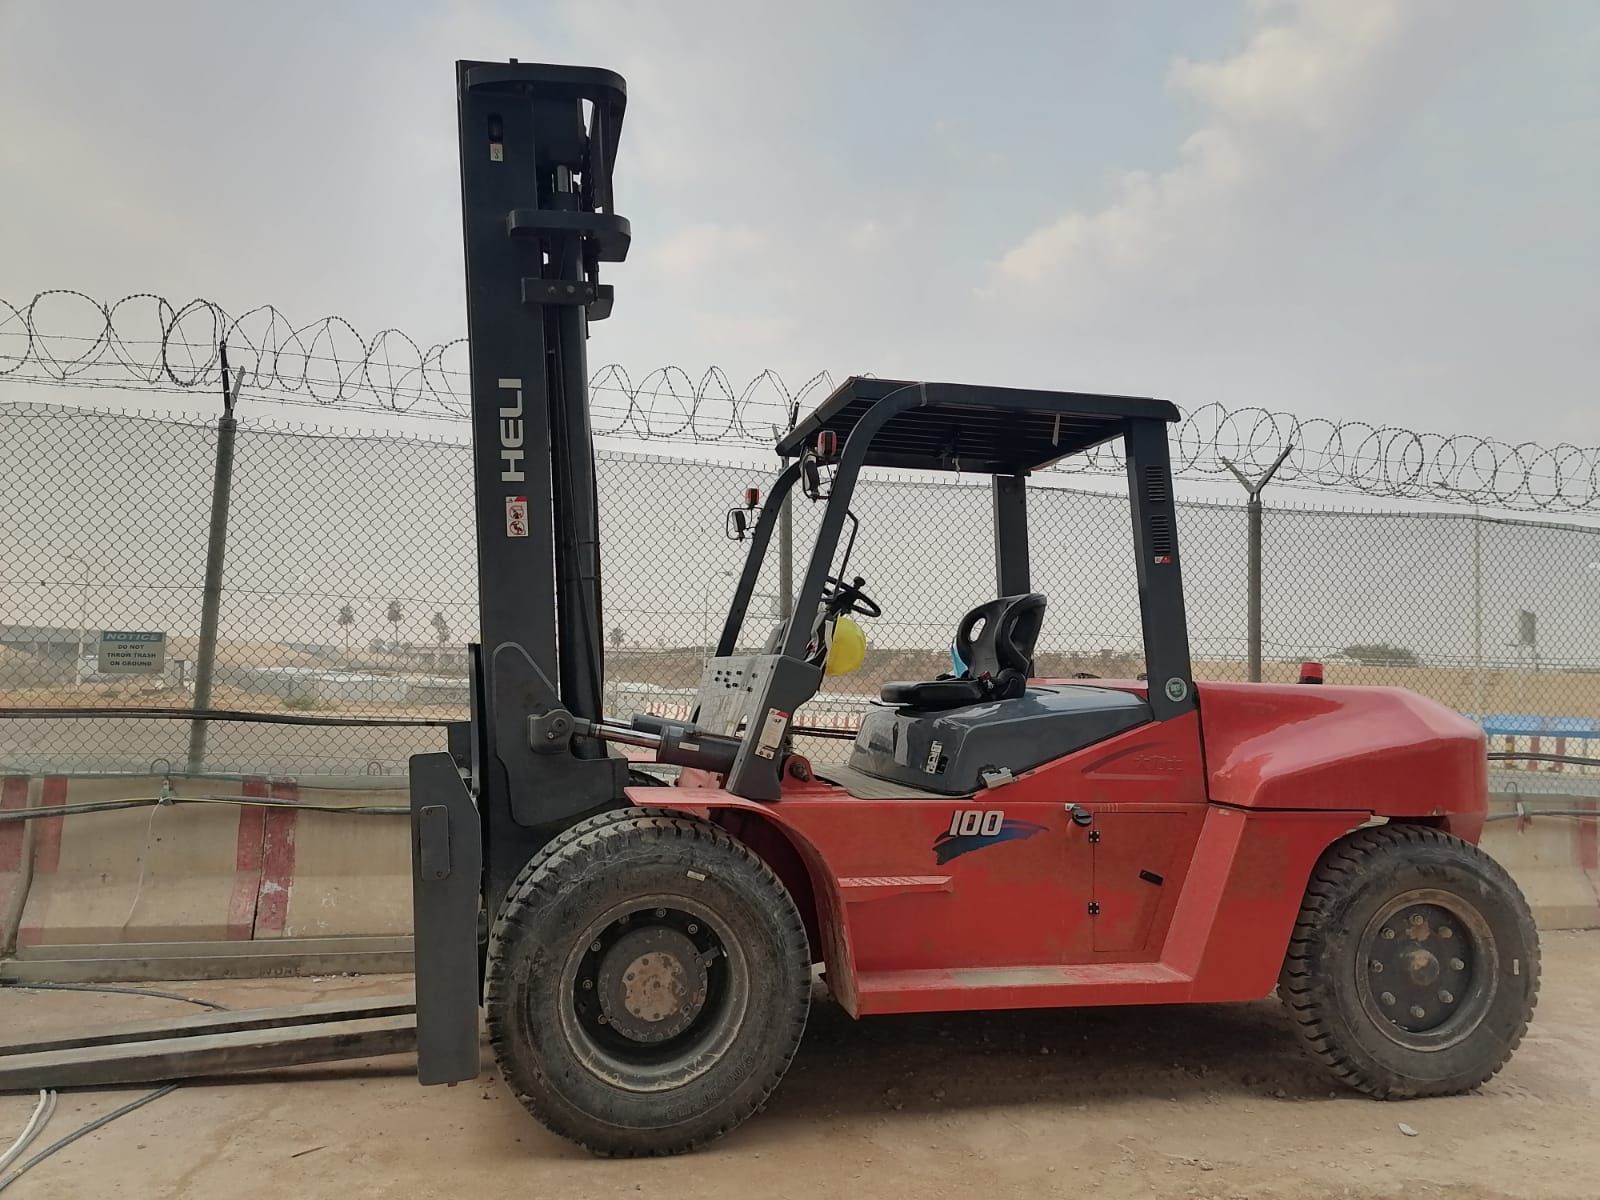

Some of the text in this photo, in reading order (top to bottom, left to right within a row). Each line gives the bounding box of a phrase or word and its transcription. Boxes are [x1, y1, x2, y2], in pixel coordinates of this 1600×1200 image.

[499, 378, 525, 482] HELI
[106, 633, 159, 641] NOTICE
[949, 810, 1004, 836] 100
